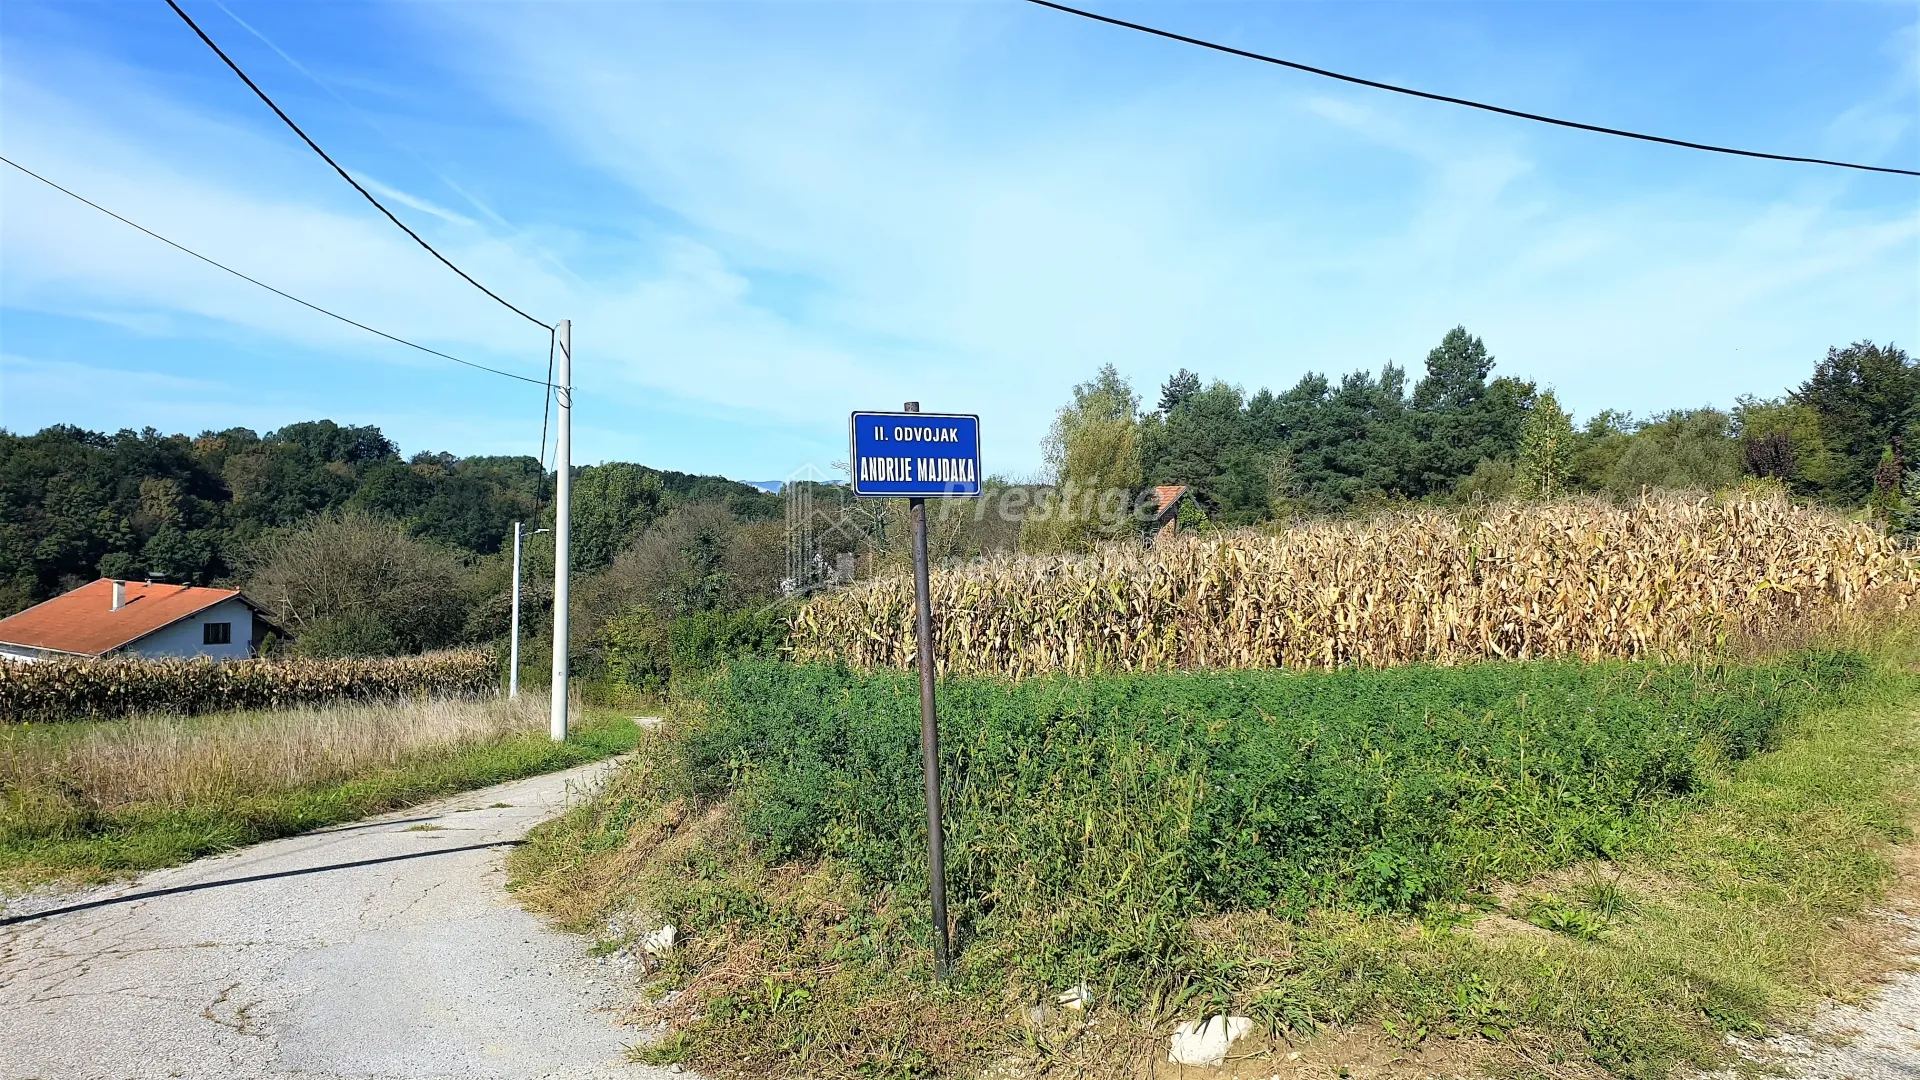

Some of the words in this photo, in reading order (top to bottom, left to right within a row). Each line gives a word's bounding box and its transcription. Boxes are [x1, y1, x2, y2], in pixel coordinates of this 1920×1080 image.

[874, 426, 889, 441] II.
[894, 427, 959, 442] ODVOJAK
[860, 457, 913, 482] ANDRIJE
[917, 458, 976, 482] MAJDAKA
